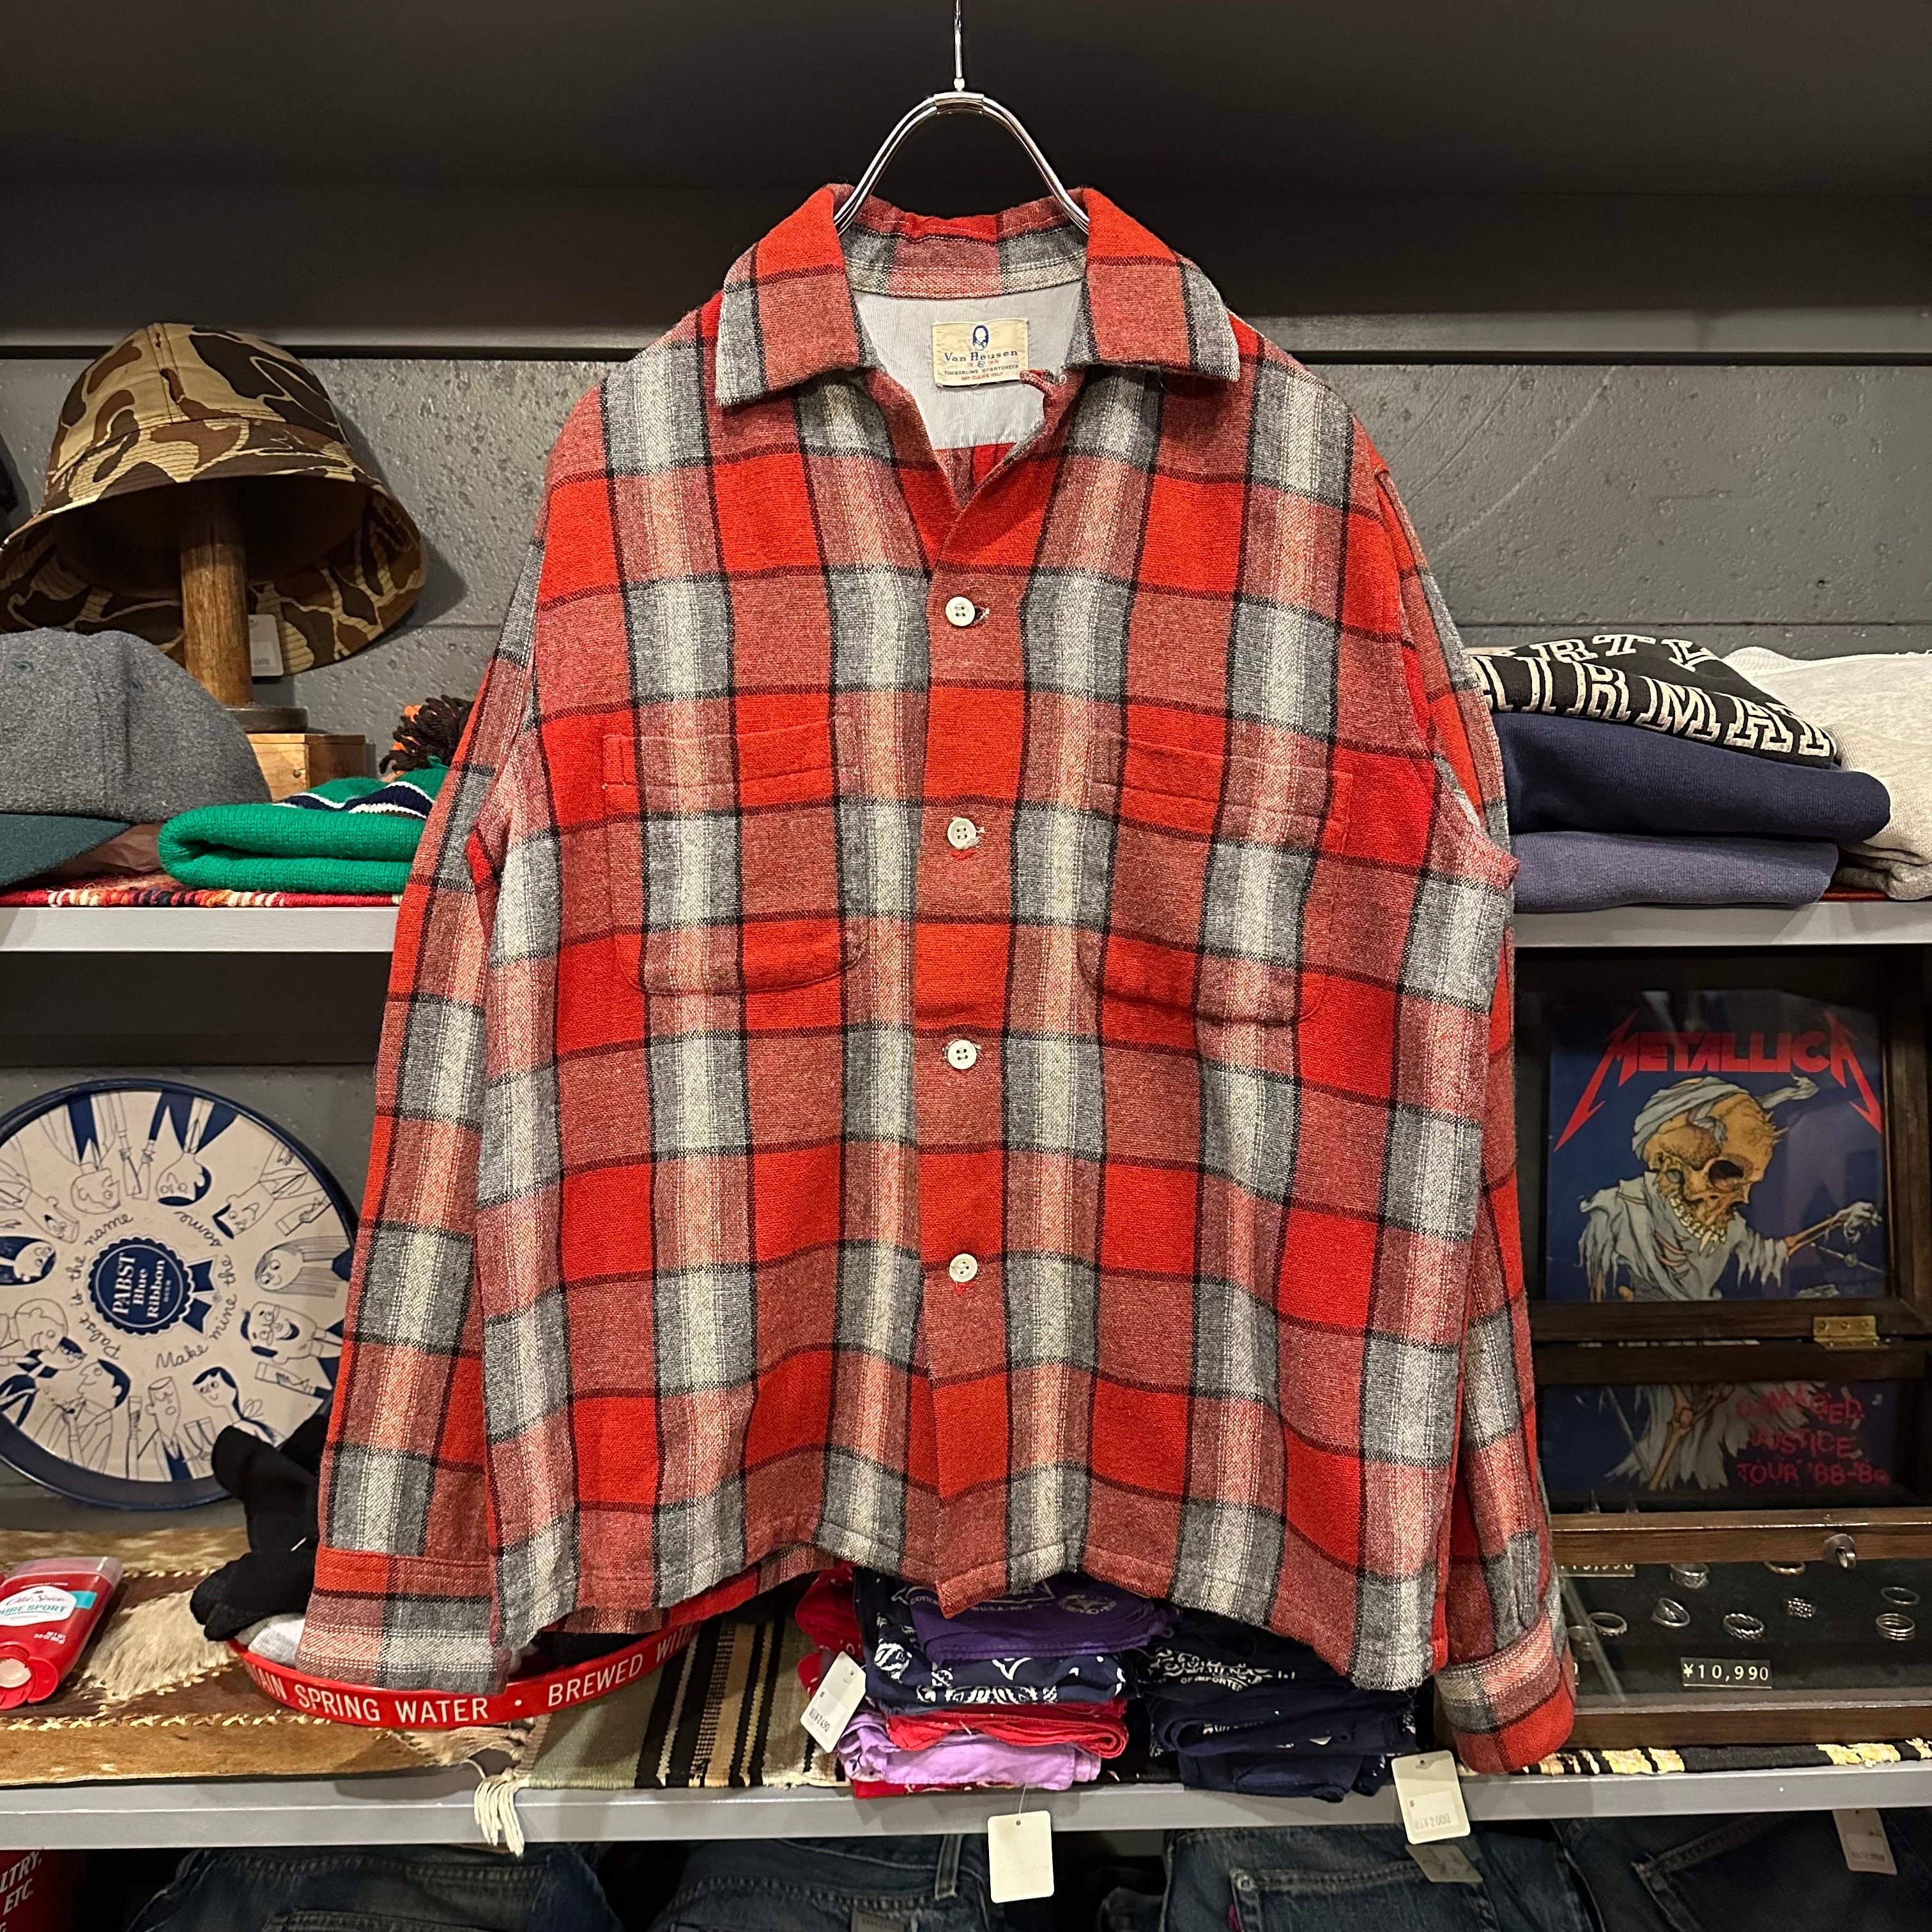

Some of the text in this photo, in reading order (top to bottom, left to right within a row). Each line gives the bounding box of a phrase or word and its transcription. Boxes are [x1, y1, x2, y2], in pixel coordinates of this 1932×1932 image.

[944, 351, 1018, 362] Van Heusen
[1553, 1009, 1882, 1153] METALLICA
[65, 1214, 134, 1360] Pabst is the name
[112, 1252, 136, 1315] PABST
[133, 1268, 148, 1305] Blue
[147, 1260, 165, 1318] Ribbon
[155, 1211, 238, 1369] Make mine the same
[1736, 1461, 1799, 1487] TOUR
[27, 1604, 66, 1613] SPORT
[293, 1684, 381, 1722] SPRING
[394, 1697, 489, 1724] WATER
[548, 1653, 644, 1707] BREWED
[1683, 1663, 1770, 1683] ¥10,990
[3, 1878, 34, 1916] ETC.
